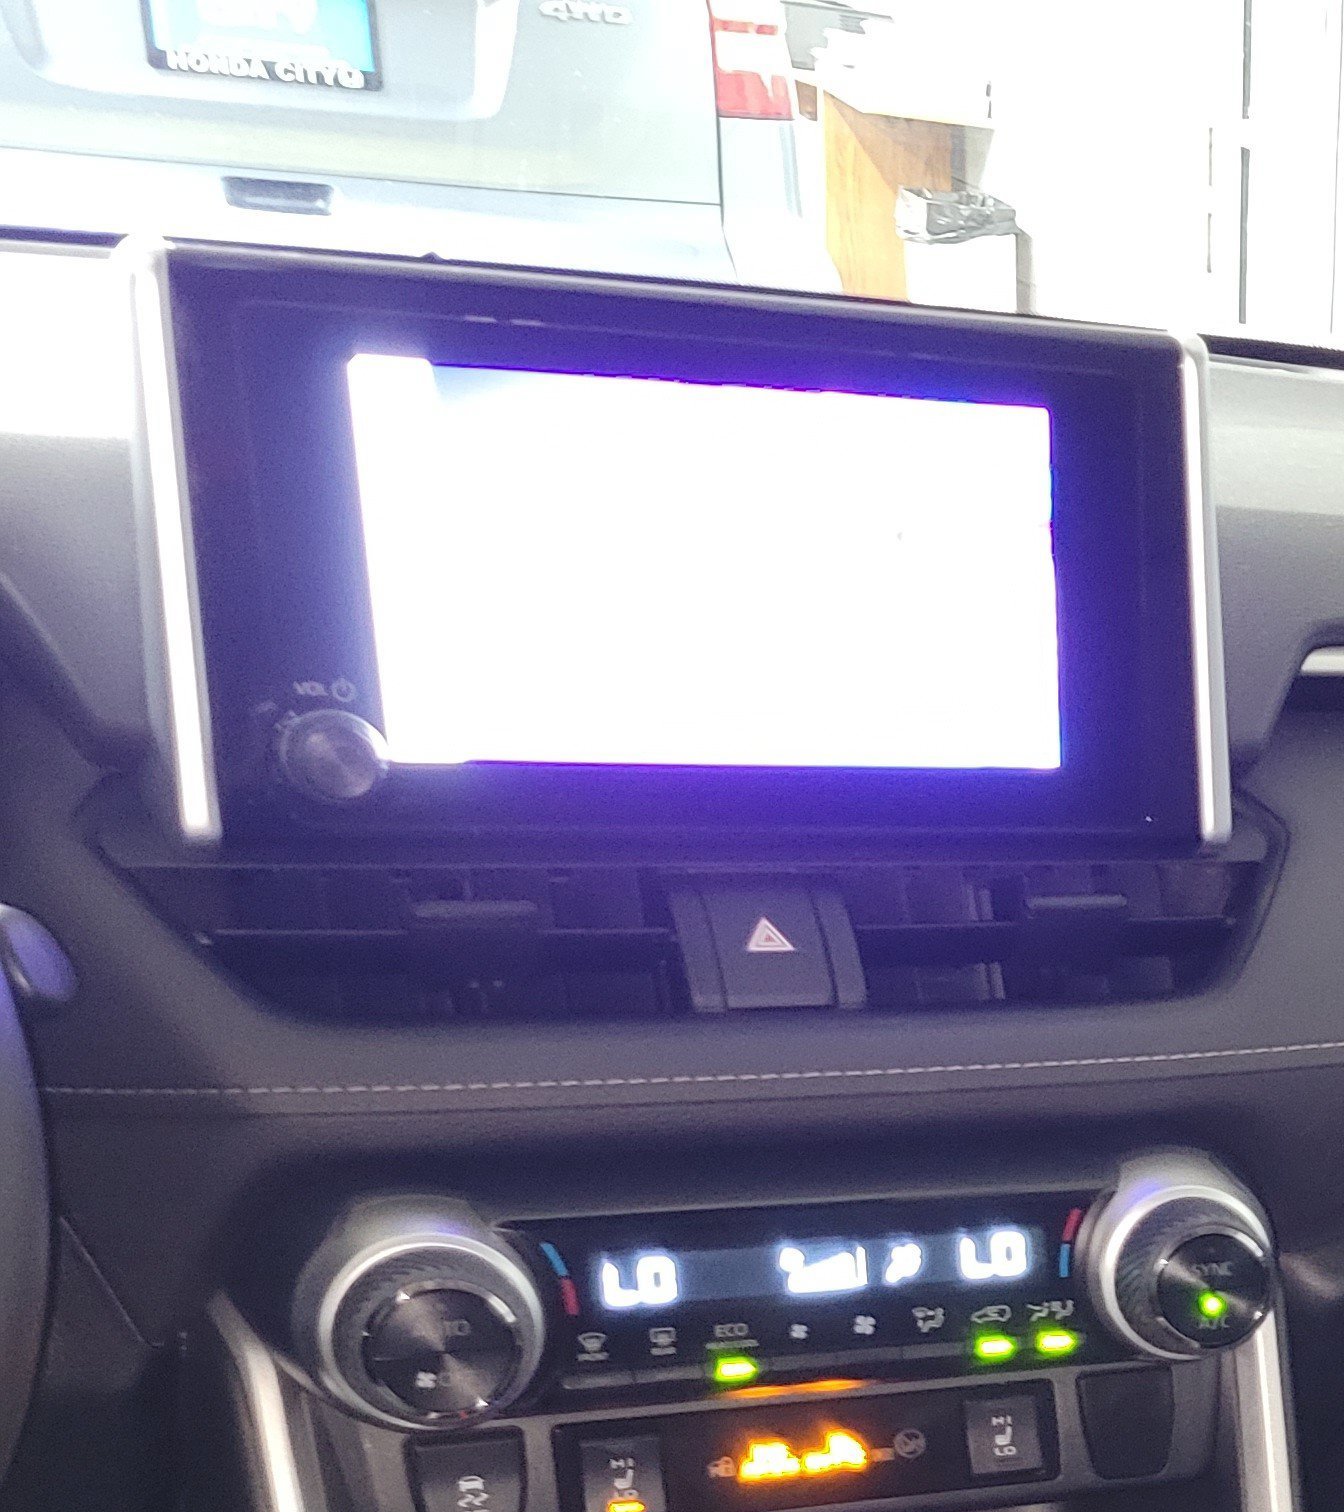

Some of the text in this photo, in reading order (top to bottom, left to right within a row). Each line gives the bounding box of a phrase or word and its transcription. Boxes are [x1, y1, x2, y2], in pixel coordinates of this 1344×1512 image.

[165, 50, 270, 80] HONDA
[957, 1230, 1028, 1280] LO
[601, 1255, 679, 1308] LO
[714, 1322, 749, 1338] ECO
[991, 1414, 1013, 1427] HI
[992, 1445, 1017, 1457] LO
[609, 1456, 636, 1469] HI
